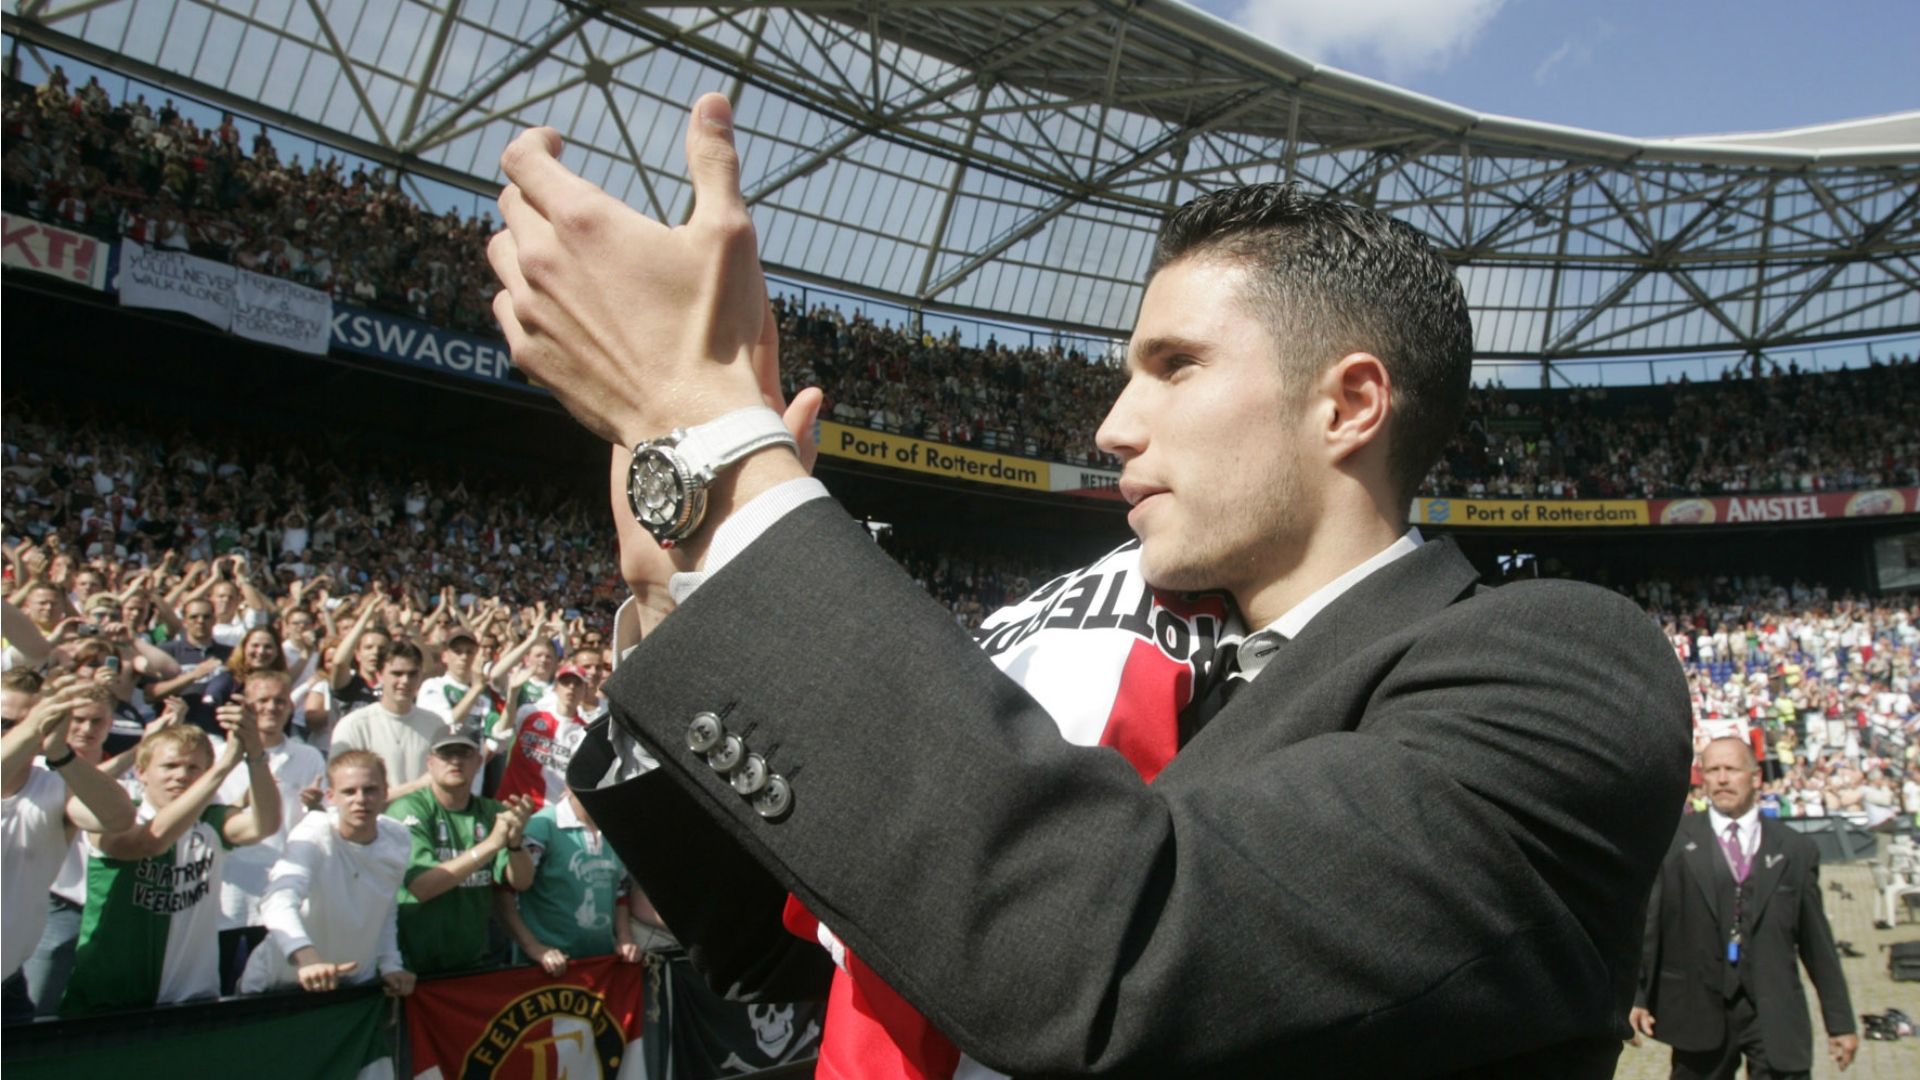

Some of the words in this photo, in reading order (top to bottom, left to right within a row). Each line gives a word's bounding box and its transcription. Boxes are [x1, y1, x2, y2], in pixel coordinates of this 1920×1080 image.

[840, 431, 888, 459] Port
[895, 444, 919, 464] of
[926, 447, 1038, 484] Rotterdam
[1466, 505, 1505, 521] Port
[1510, 504, 1530, 521] of
[1536, 504, 1637, 522] Rotterdam
[1726, 496, 1827, 523] AMSTEL
